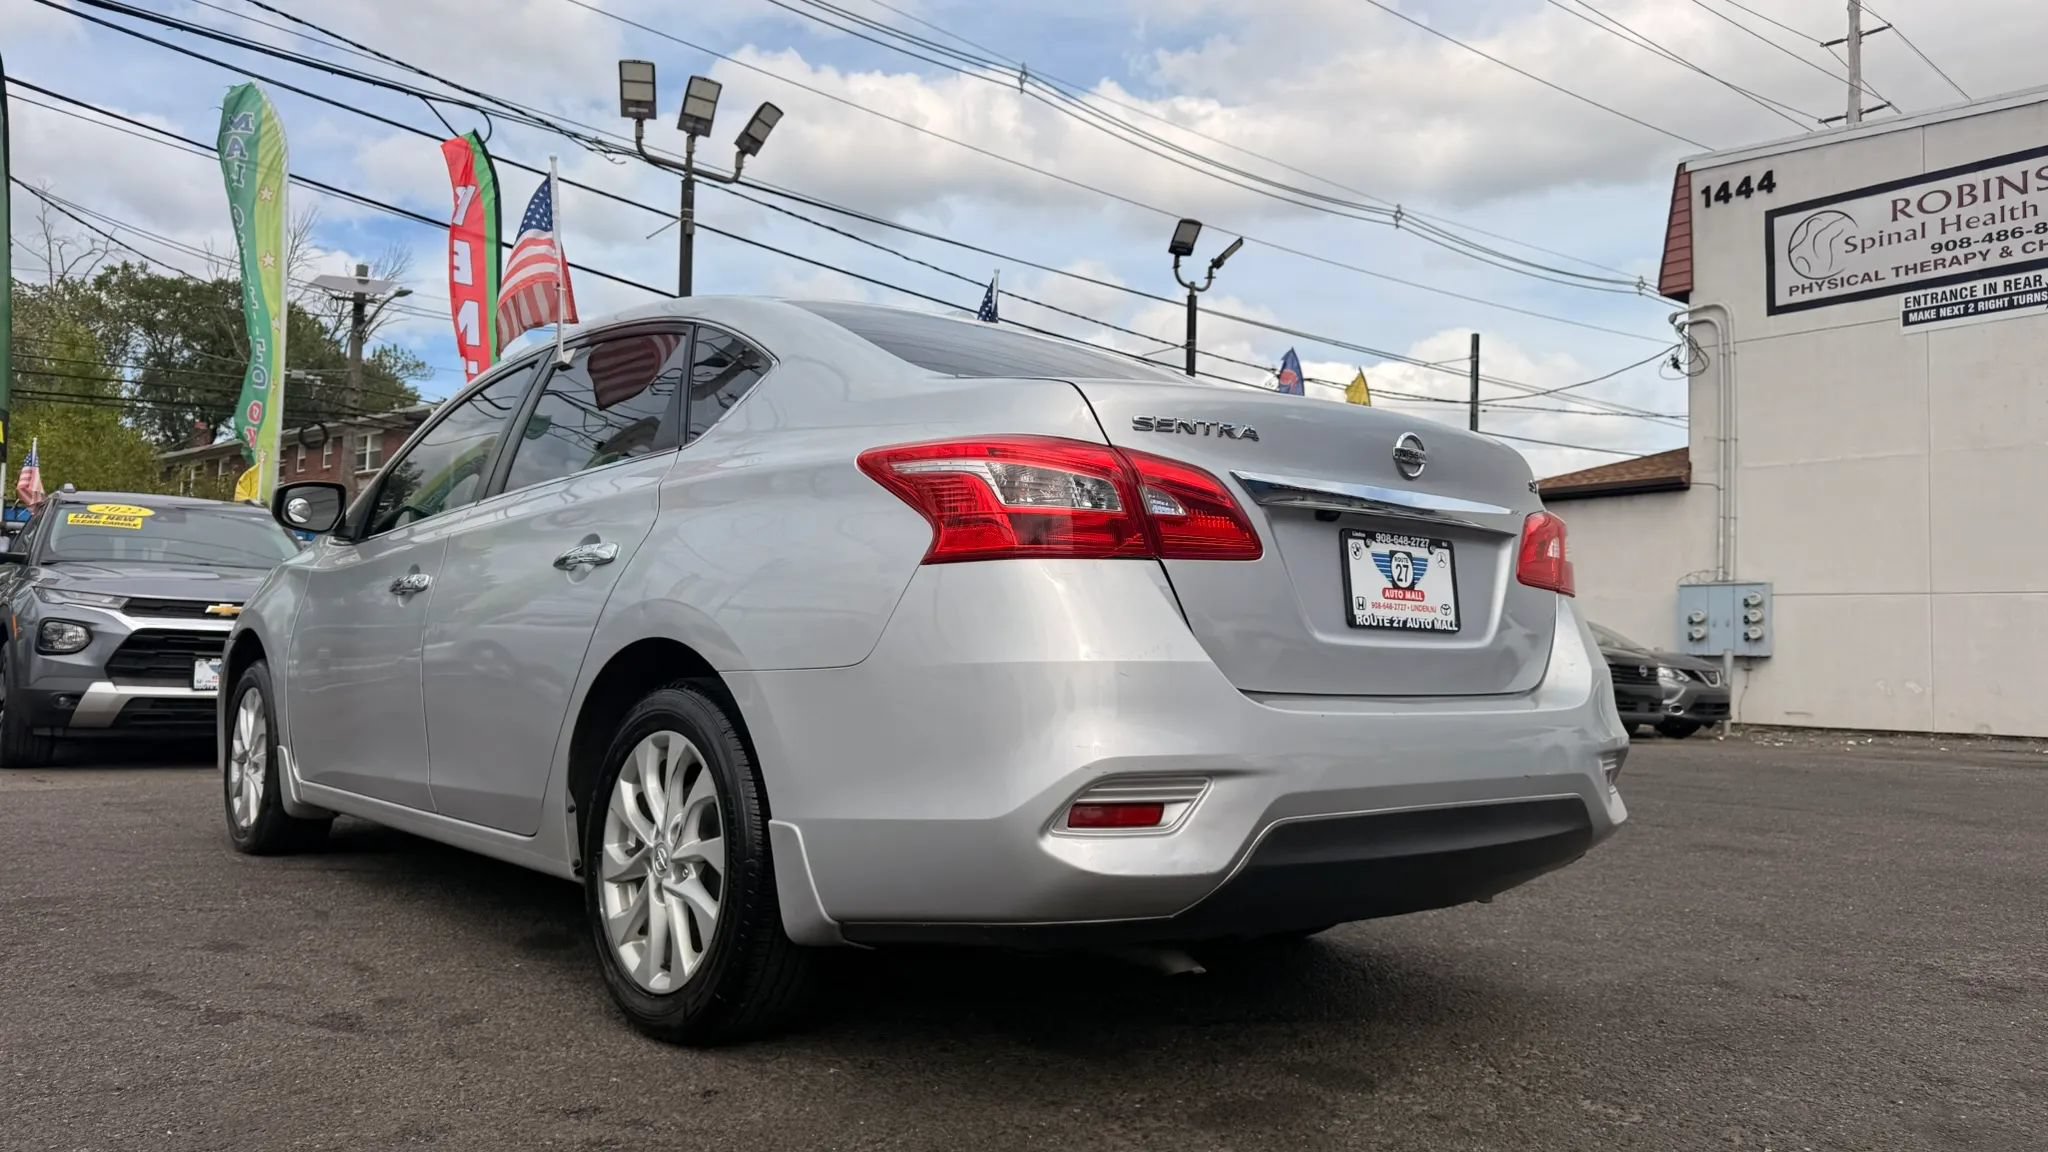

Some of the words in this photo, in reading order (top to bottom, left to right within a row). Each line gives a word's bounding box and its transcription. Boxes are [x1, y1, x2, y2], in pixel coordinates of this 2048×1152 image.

[1701, 169, 1776, 208] 1444
[1891, 164, 2048, 222] ROBINS
[1844, 221, 1926, 254] Spinal
[1940, 200, 2039, 236] Health
[1930, 222, 2048, 254] 908-486-8
[1789, 269, 1886, 297] PHYSICAL
[1891, 248, 1991, 278] THERAPY
[1999, 245, 2013, 258] &
[1904, 284, 1978, 309] ENTRANCE
[1983, 281, 1998, 296] IN
[2003, 274, 2043, 293] REAR
[1908, 308, 1937, 323] MAKE
[1939, 304, 1965, 318] NEXT
[1967, 302, 1975, 313] 2
[1977, 297, 2009, 312] RIGHT
[2012, 291, 2048, 306] TURNS
[1132, 415, 1260, 441] SENTRA
[105, 514, 137, 522] NEW
[1375, 532, 1430, 548] 908-648-2727
[1395, 563, 1409, 583] 27
[1384, 589, 1403, 599] AUTO
[1406, 591, 1423, 600] MALL
[1356, 614, 1391, 627] ROUTE
[1392, 616, 1404, 628] 27
[1406, 617, 1432, 629] AUTO
[1434, 618, 1458, 631] MALL
